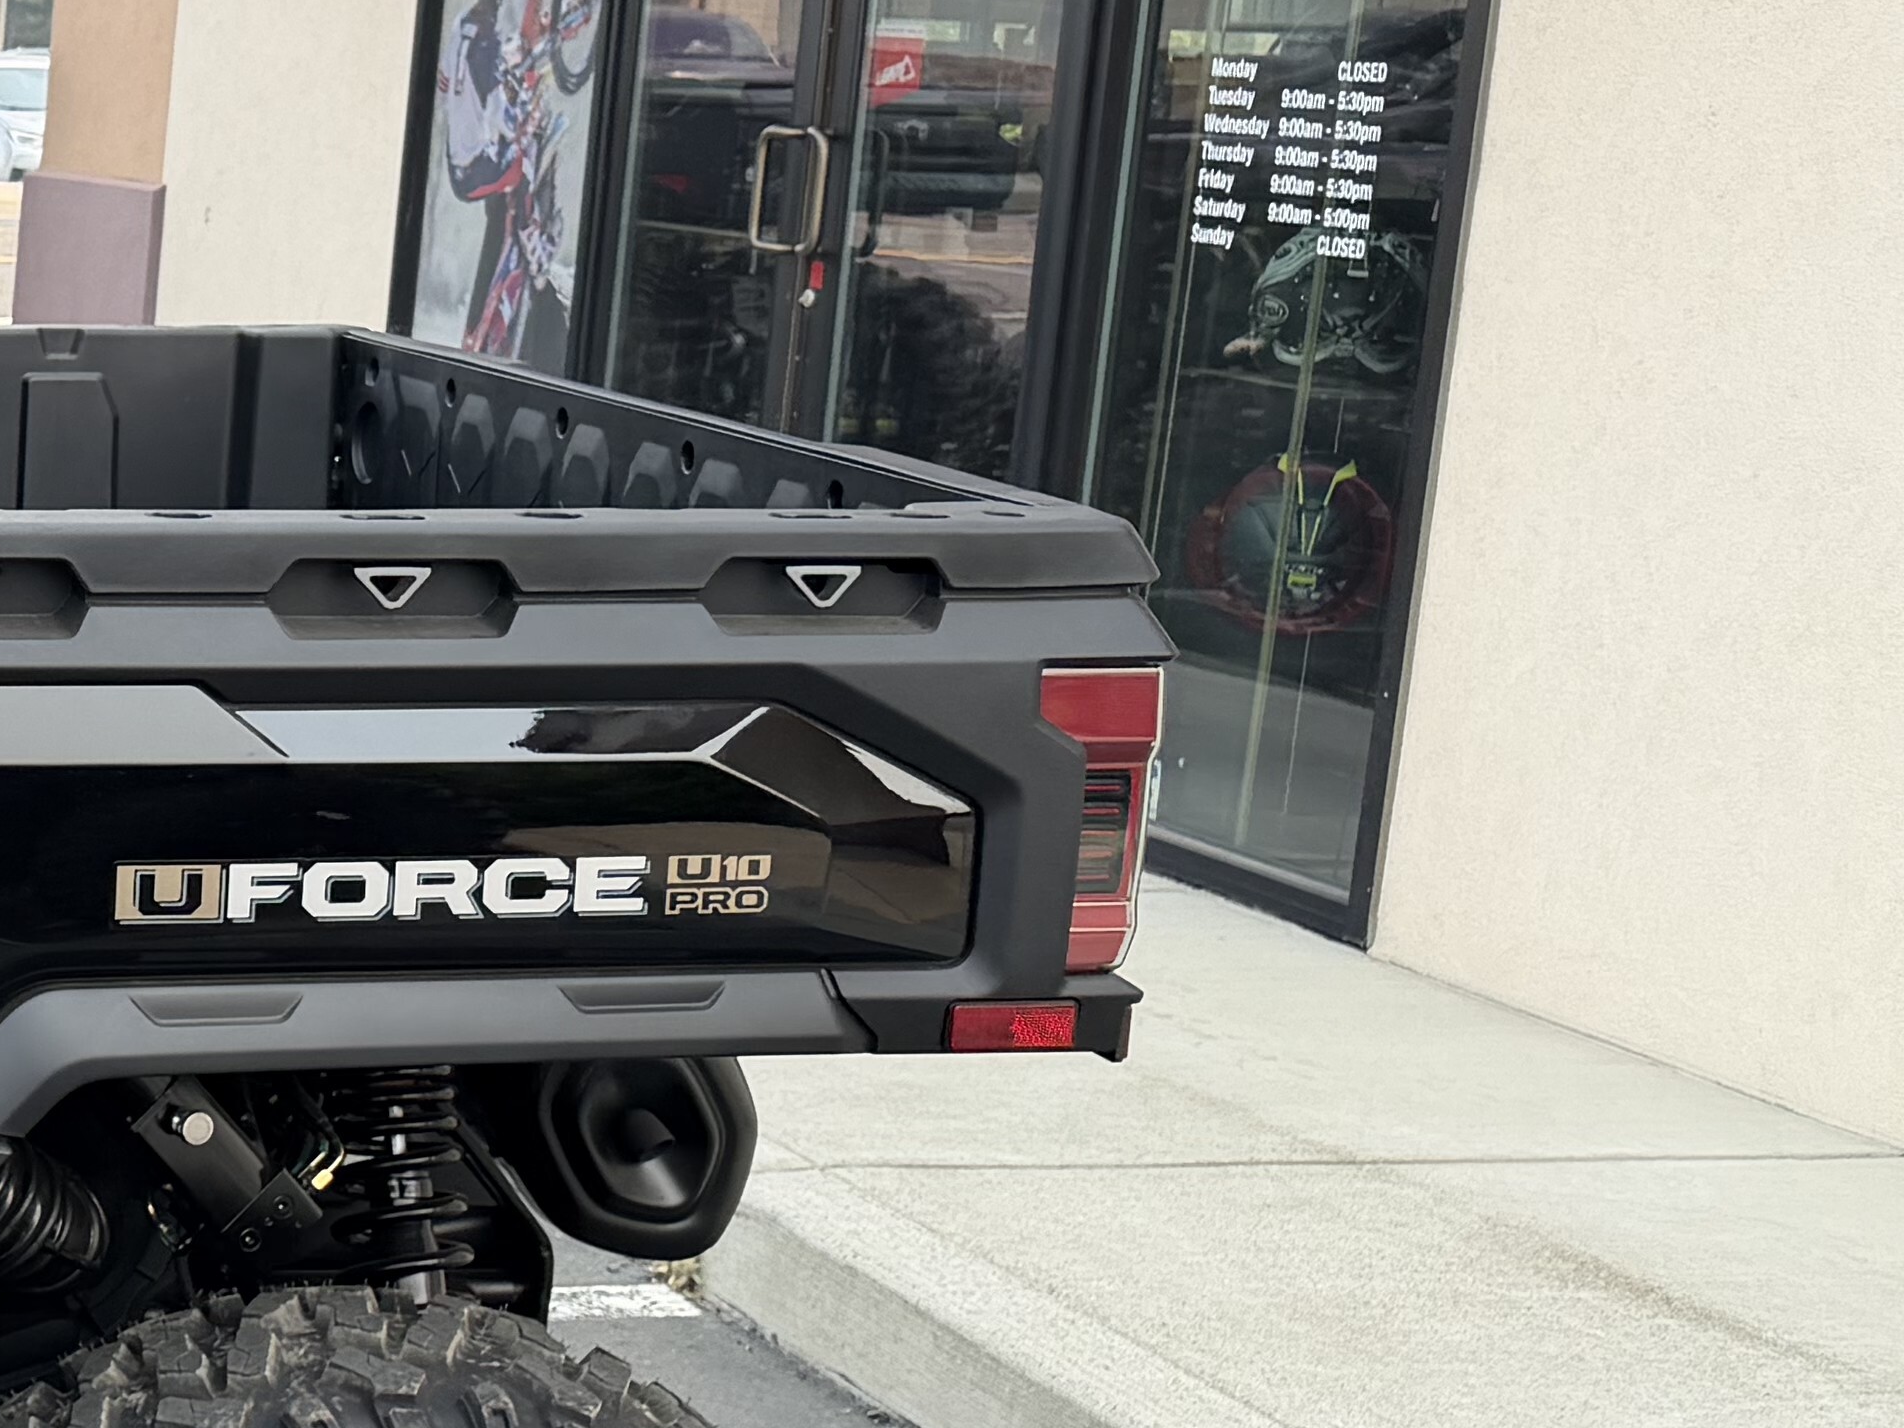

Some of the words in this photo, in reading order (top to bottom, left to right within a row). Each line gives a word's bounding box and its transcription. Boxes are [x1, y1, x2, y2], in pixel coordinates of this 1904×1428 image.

[1211, 57, 1259, 82] Monday
[1337, 61, 1388, 83] CLOSED
[1208, 85, 1255, 110] Tuesday
[1281, 89, 1326, 109] 9:00am
[1337, 90, 1385, 115] 5:30pm
[1204, 113, 1270, 139] Wednesday
[1278, 117, 1323, 139] 9:00am
[1334, 120, 1382, 145] 5:30pm
[1201, 140, 1254, 167] Thursday
[1274, 145, 1319, 167] 9:00am
[1330, 149, 1378, 174] 5:30pm
[1198, 168, 1235, 193] Friday
[1270, 174, 1315, 196] 9:00am
[1325, 178, 1373, 203] 5:30pm
[1193, 195, 1246, 223] Saturday
[1267, 202, 1312, 225] 9:00am
[1323, 208, 1371, 232] 5:00pm
[1191, 223, 1235, 250] Sunday
[1316, 235, 1366, 259] CLOSED
[668, 854, 772, 884] U10
[113, 855, 651, 925] UFORCE
[664, 886, 769, 915] PRO
